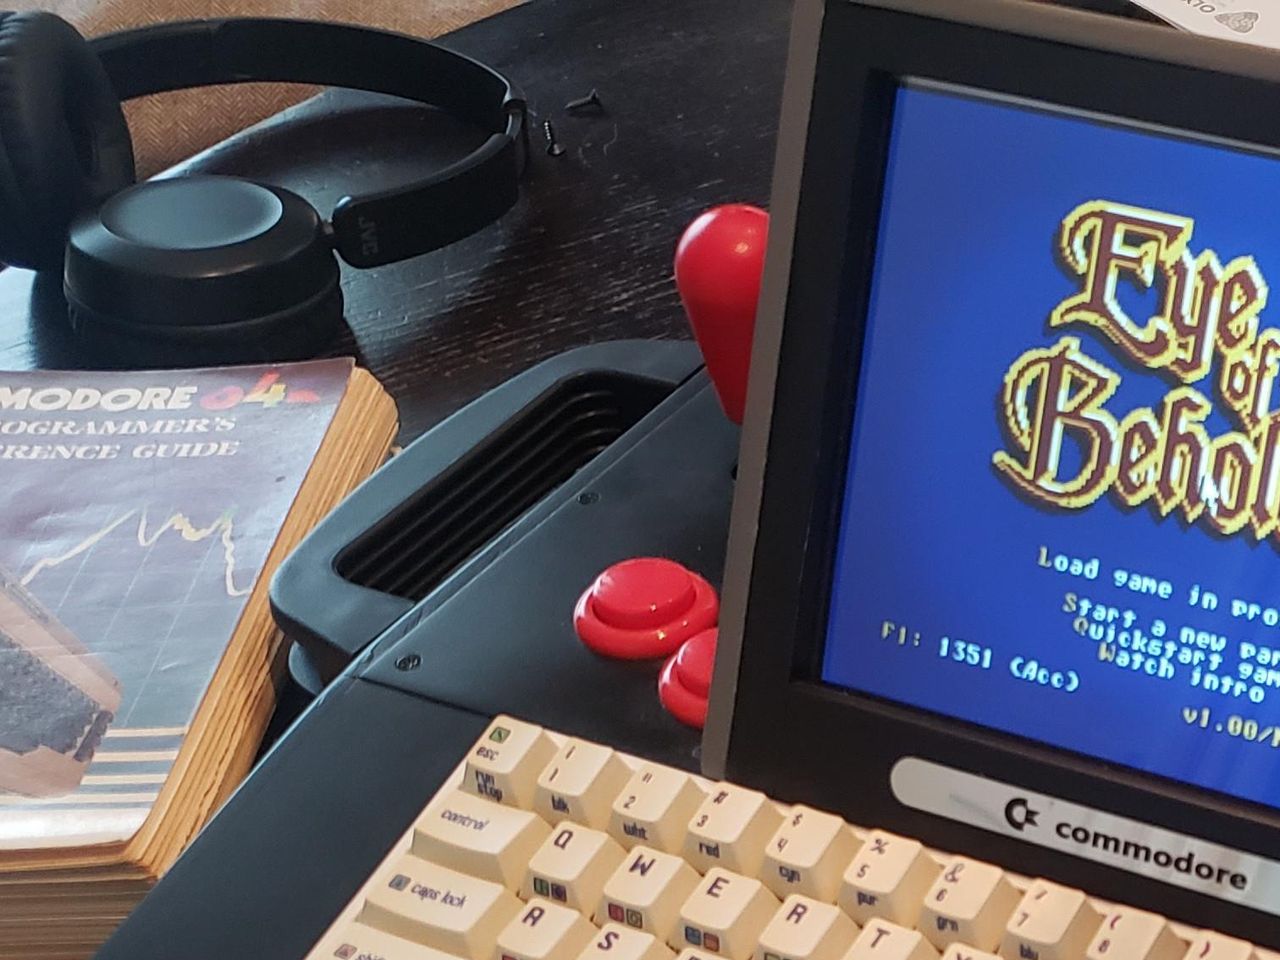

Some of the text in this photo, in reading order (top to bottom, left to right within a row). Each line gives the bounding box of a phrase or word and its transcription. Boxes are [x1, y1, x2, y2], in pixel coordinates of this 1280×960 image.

[1050, 200, 1268, 383] Eye
[0, 417, 236, 435] OGRAMMER'S
[0, 440, 241, 460] RENCE GUIDE
[1038, 547, 1099, 580] Load
[1113, 568, 1173, 600] game
[1187, 582, 1217, 611] in
[1063, 592, 1136, 629] Start
[1152, 620, 1166, 637] a
[1181, 625, 1226, 652] new
[1073, 617, 1221, 671] Quickstart
[939, 635, 992, 670] 1351
[1011, 657, 1081, 693] (Acc)
[1099, 643, 1266, 704] Watch intro
[476, 746, 499, 761] esc
[623, 796, 636, 809] 2
[440, 808, 491, 831] control
[697, 815, 708, 828] 3
[553, 830, 573, 851] Q
[629, 855, 656, 876] W
[1055, 819, 1248, 891] commodore
[857, 864, 870, 879] 5
[411, 883, 468, 909] caps lock
[707, 877, 730, 898] E
[522, 906, 545, 927] A
[786, 903, 807, 924] R
[597, 931, 620, 951] S
[869, 928, 890, 948] T
